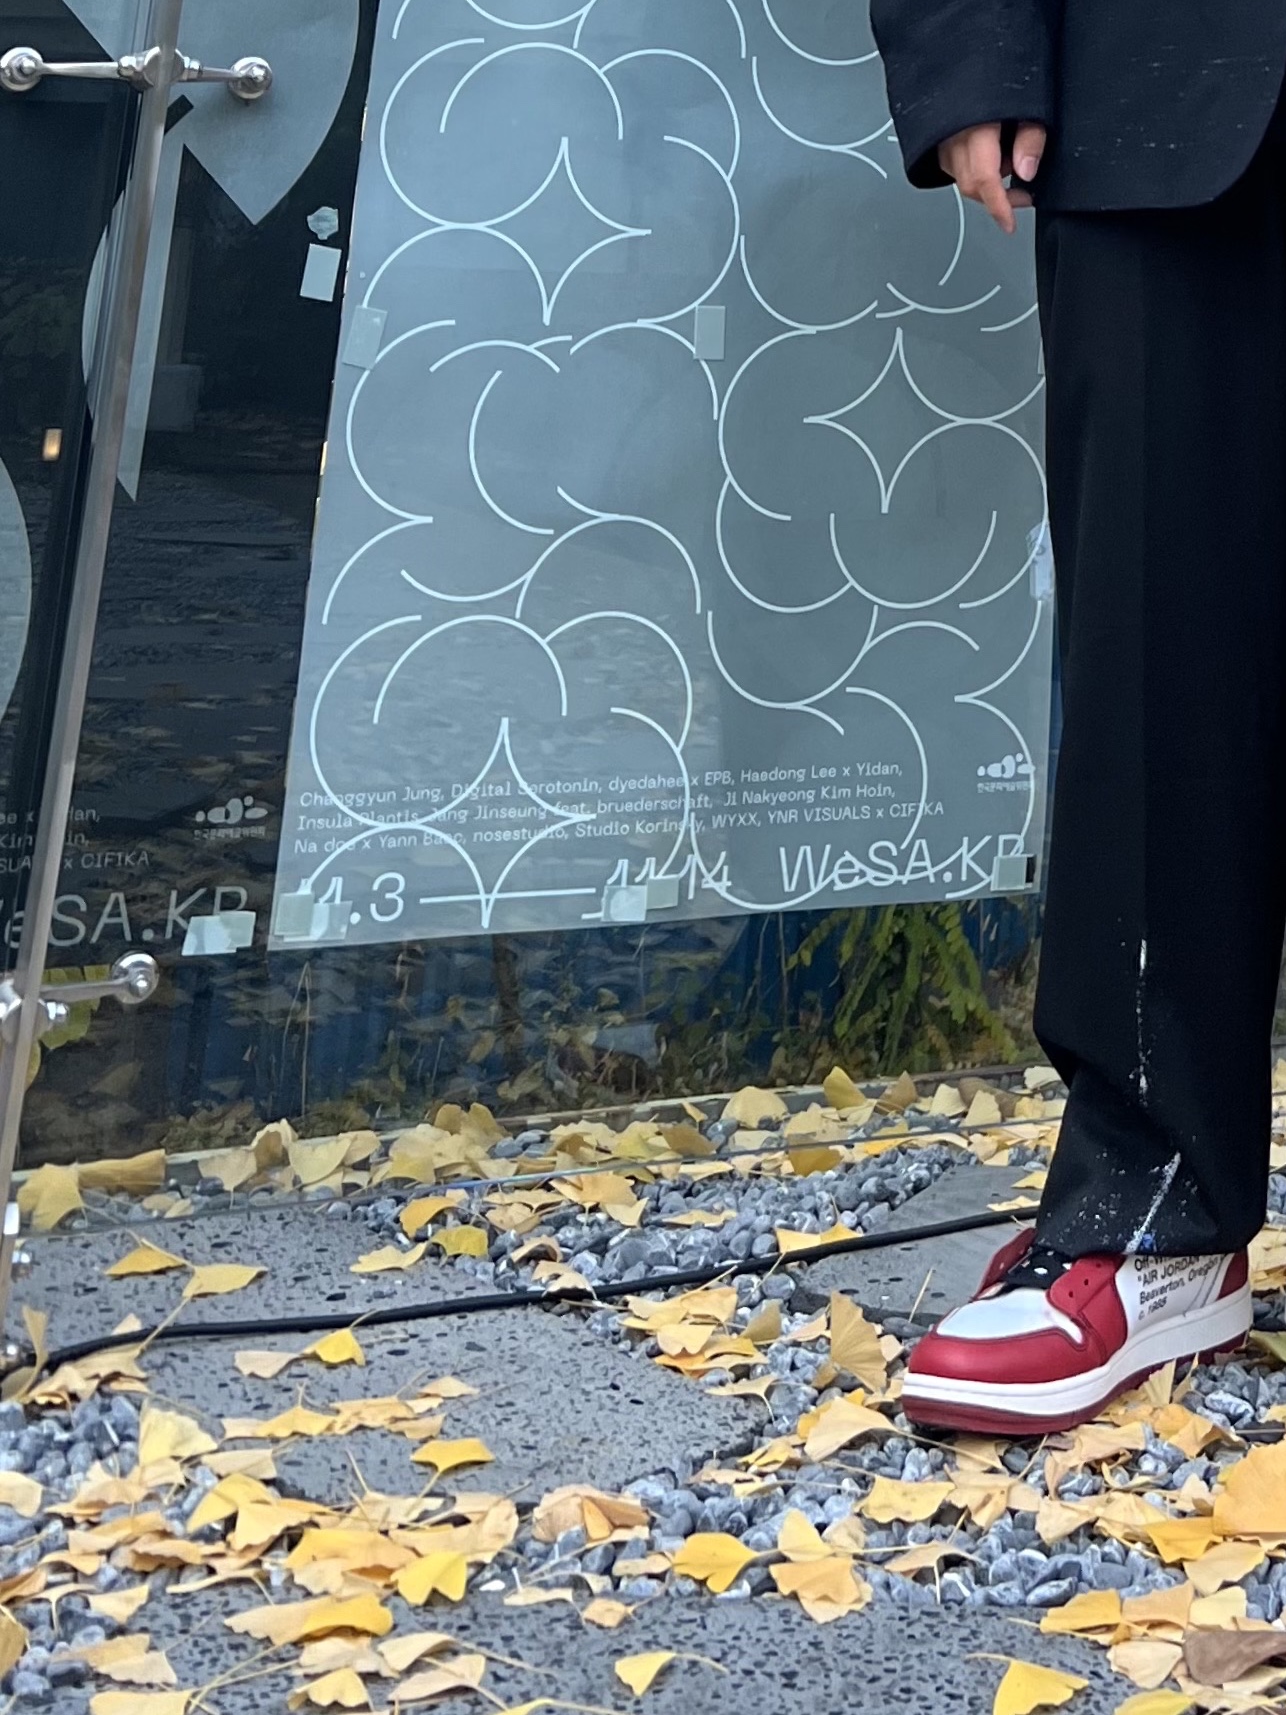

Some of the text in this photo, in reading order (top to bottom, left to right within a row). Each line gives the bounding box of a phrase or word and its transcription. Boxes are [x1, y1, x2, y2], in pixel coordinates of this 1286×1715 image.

[297, 813, 353, 831] Insula
[474, 804, 547, 820] Jinseung
[723, 791, 737, 806] Ji
[742, 787, 815, 805] Nakyeong
[820, 785, 851, 799] Kim
[856, 783, 895, 797] Hoin,
[300, 790, 396, 807] Changgyun
[402, 786, 445, 803] Jung,
[451, 781, 511, 800] Digital
[690, 776, 699, 786] x
[704, 771, 735, 787] EPB,
[740, 767, 805, 783] Haedong
[811, 764, 837, 779] Lee
[842, 766, 851, 777] x
[856, 762, 902, 777] Yidan,
[294, 839, 318, 854] Na
[361, 838, 371, 850] x
[378, 834, 417, 849] Yann
[575, 819, 630, 838] Studio
[712, 811, 761, 829] WYXX,
[768, 809, 798, 824] YNR
[803, 805, 871, 821] VISUALS
[876, 807, 884, 818] x
[63, 857, 73, 869] x
[80, 850, 150, 869] CIFIKA
